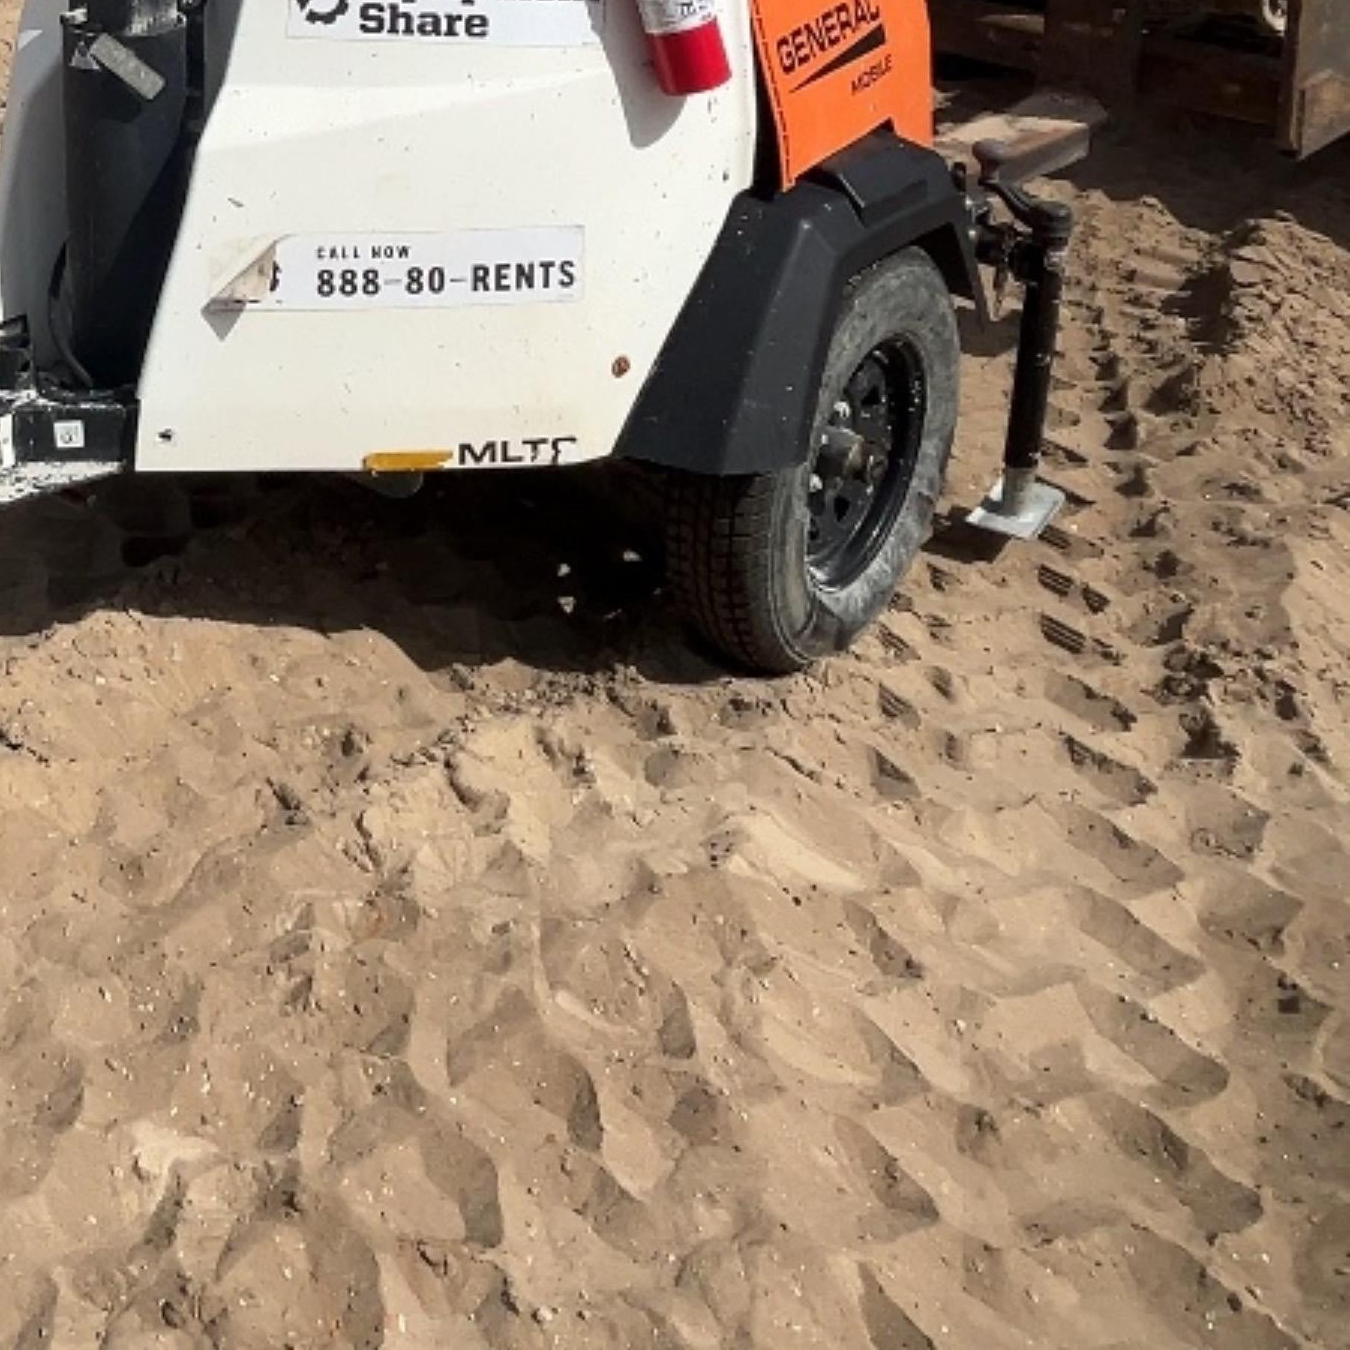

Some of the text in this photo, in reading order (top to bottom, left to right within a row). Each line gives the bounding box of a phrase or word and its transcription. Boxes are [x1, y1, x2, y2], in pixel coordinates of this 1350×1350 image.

[359, 3, 490, 38] Share
[851, 53, 894, 96] MOBILE
[317, 246, 361, 259] CALL
[316, 260, 576, 297] 888-80-RENTS
